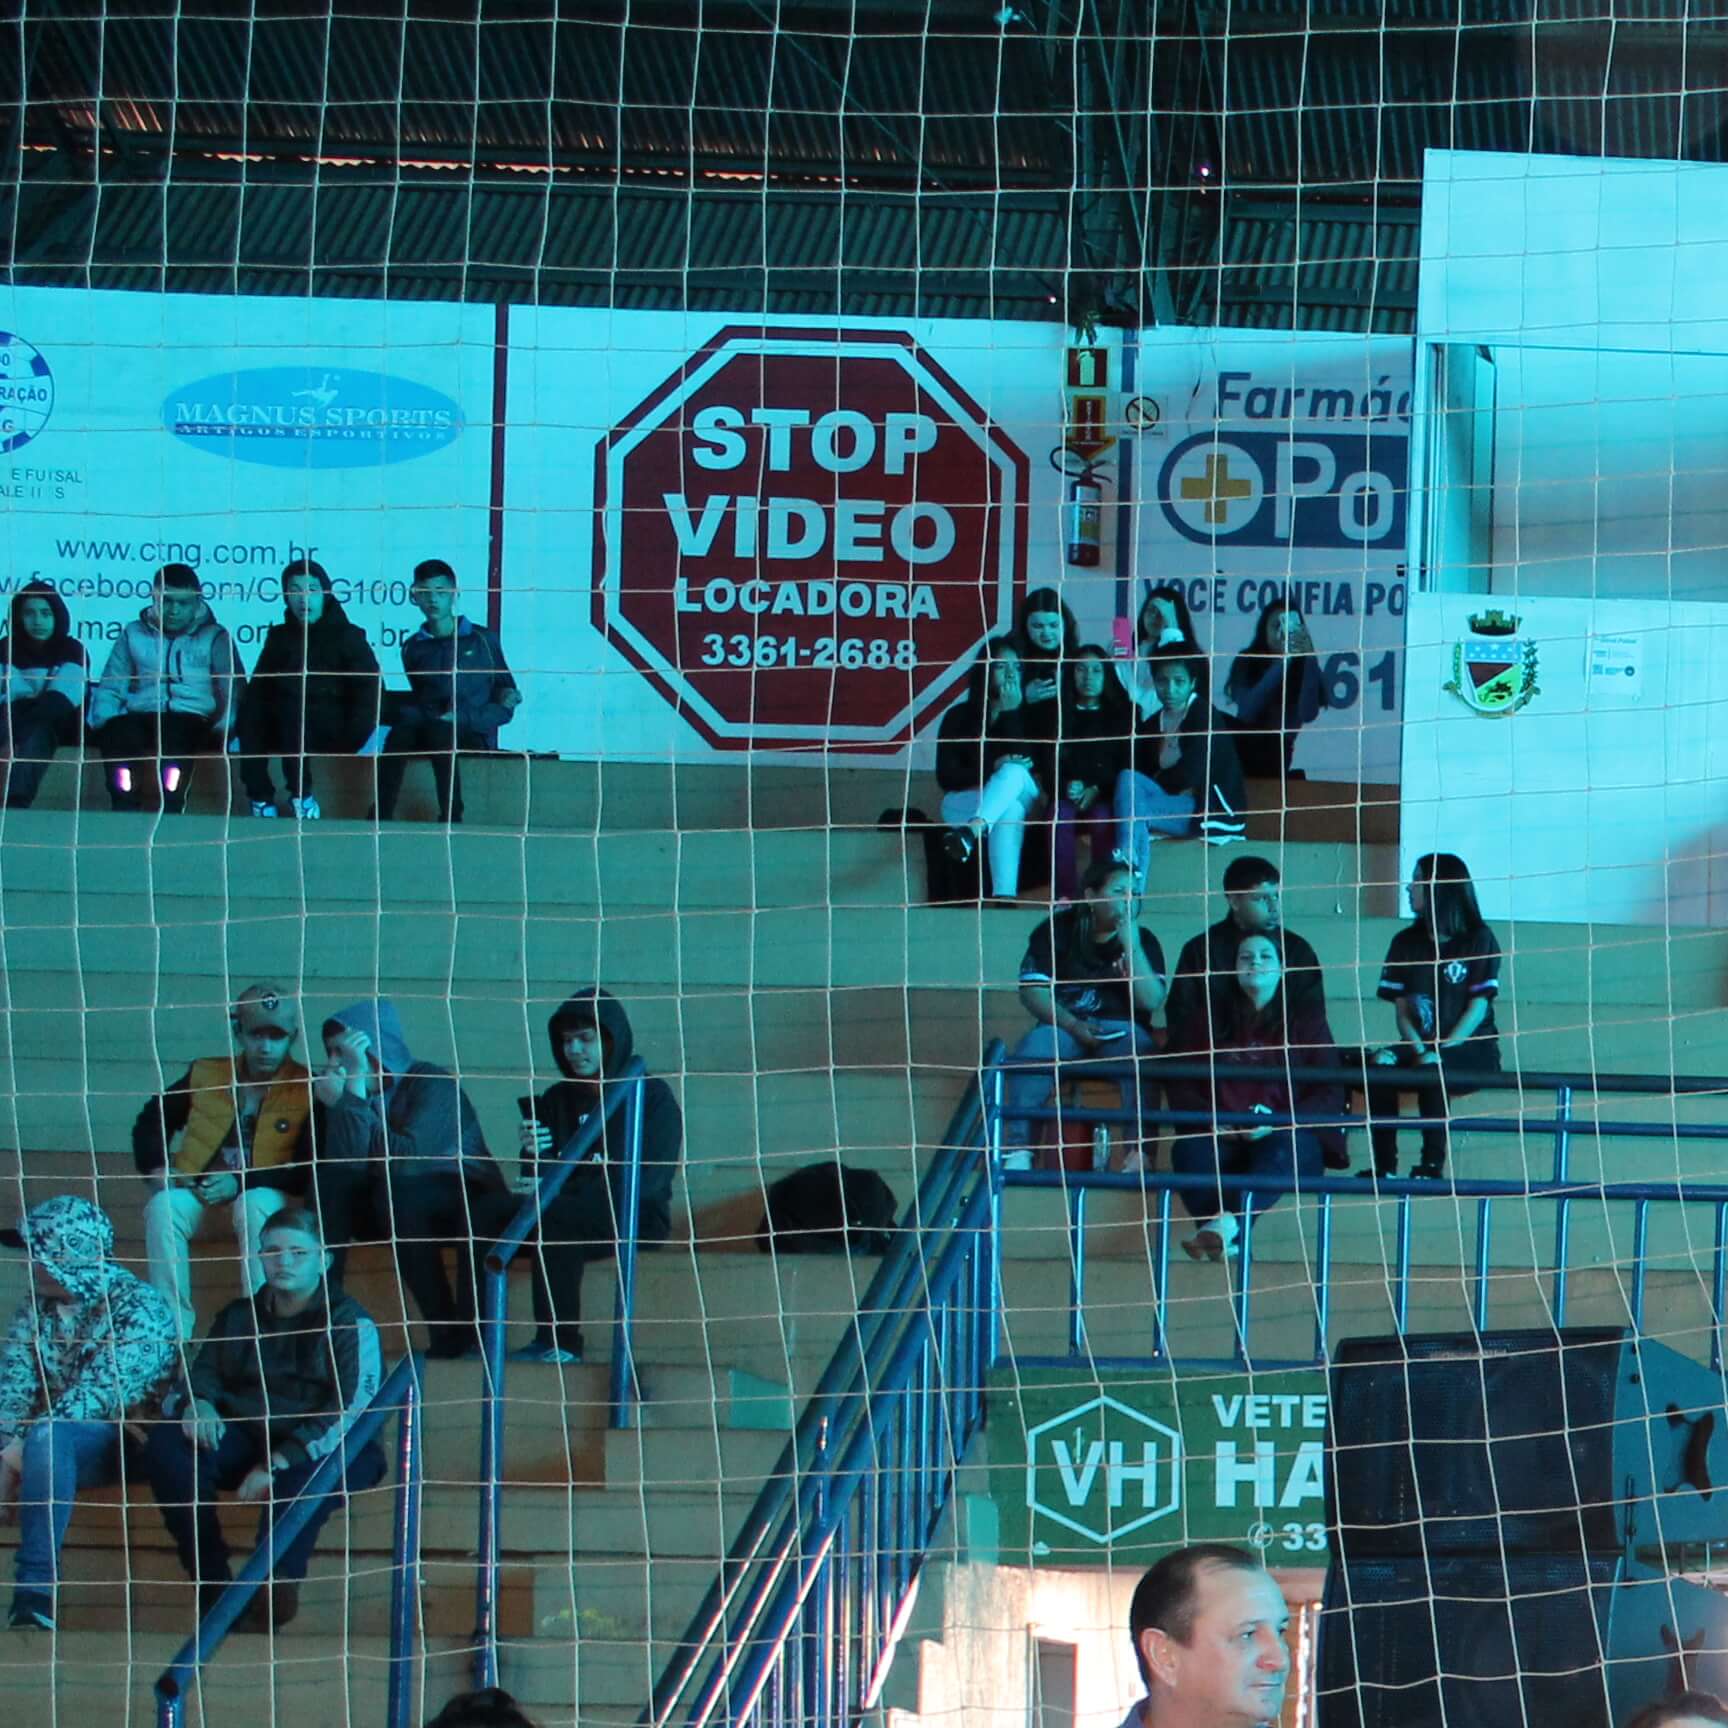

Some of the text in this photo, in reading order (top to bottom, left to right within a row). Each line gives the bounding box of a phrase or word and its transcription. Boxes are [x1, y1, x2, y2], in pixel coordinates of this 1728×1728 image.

[175, 402, 451, 430] MAGNUS SPORTS
[178, 424, 447, 440] ARTIGOS ESPORTIVOS
[692, 405, 938, 475] STOP
[662, 493, 957, 565] VIDEO
[56, 540, 319, 567] www.ctng.com.br
[675, 576, 941, 620] LOCADORA
[1237, 579, 1354, 617] CONFIA
[701, 633, 918, 671] 3361-2688
[1051, 1440, 1157, 1508] VH
